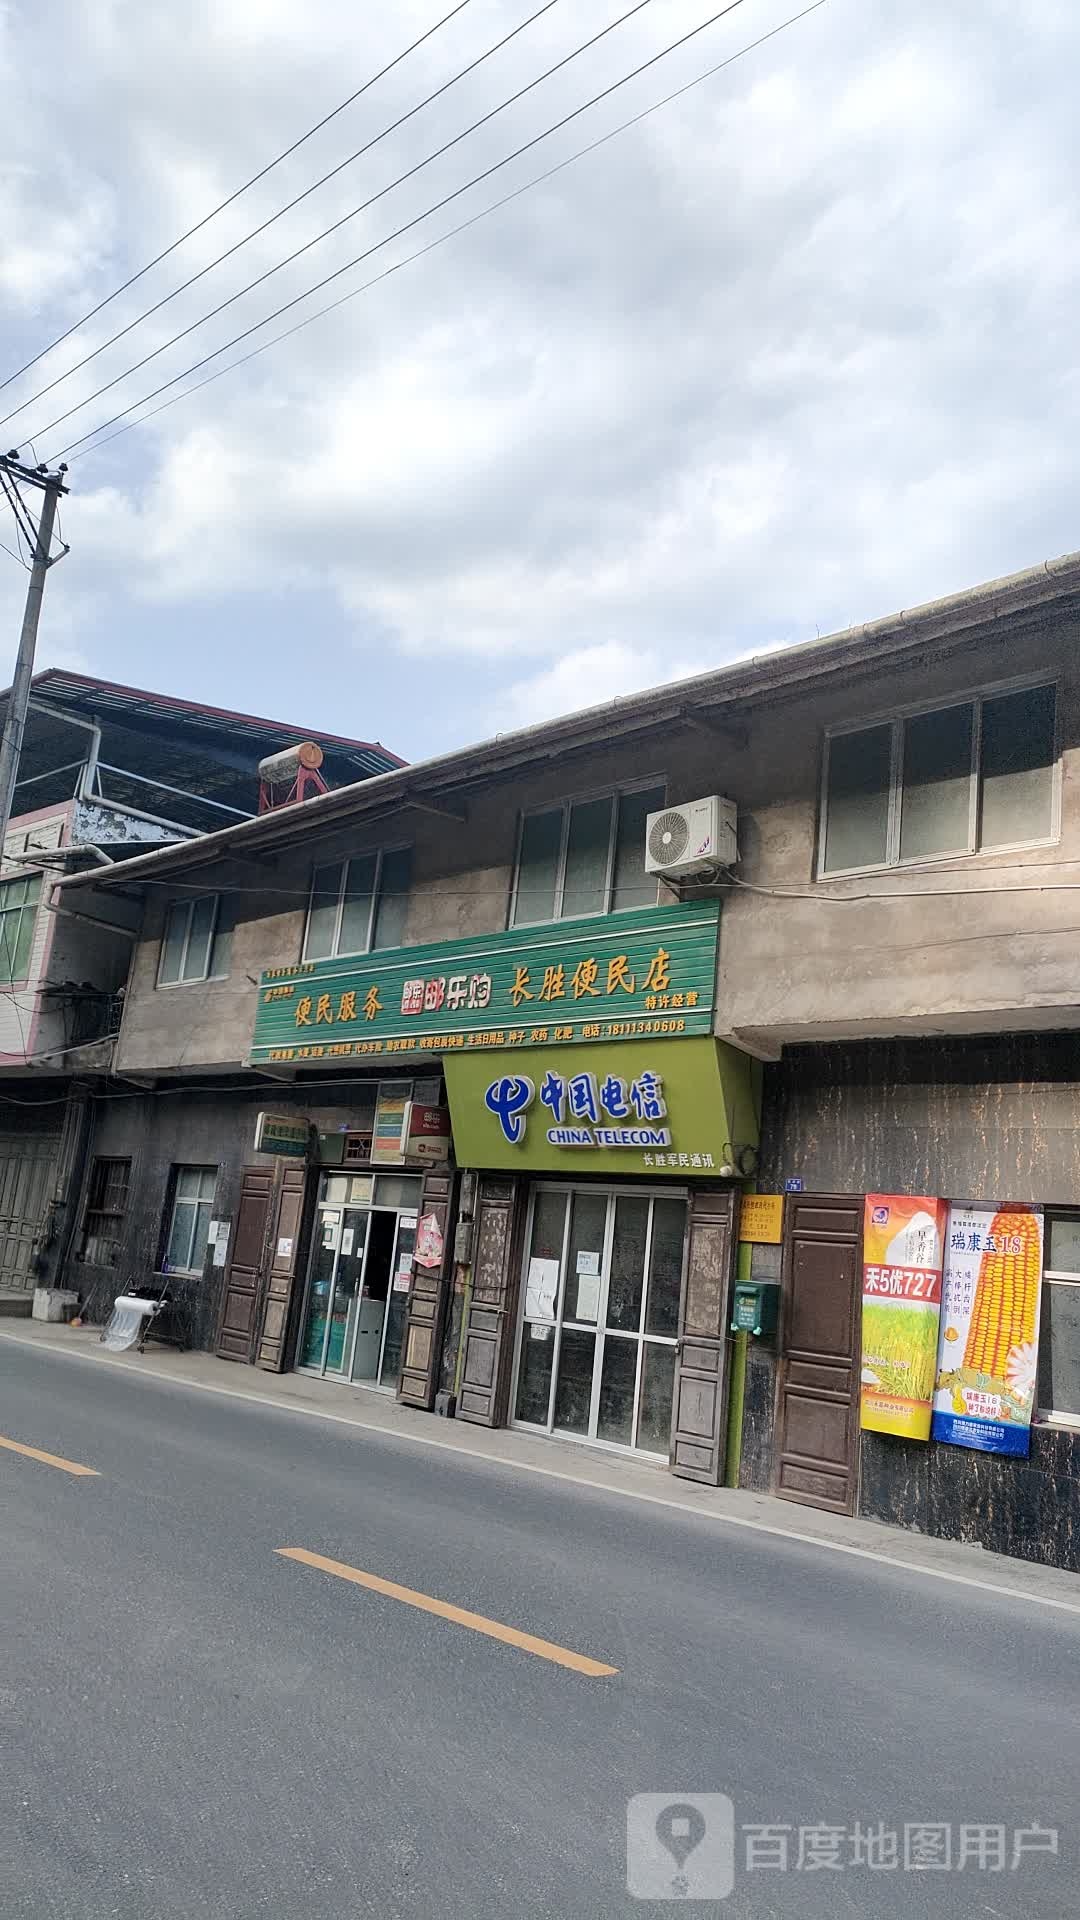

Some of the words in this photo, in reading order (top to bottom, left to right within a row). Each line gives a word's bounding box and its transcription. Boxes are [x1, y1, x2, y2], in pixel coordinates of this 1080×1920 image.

[509, 948, 671, 1007] 长胜便民店
[424, 973, 491, 1011] 邮乐购
[645, 991, 698, 1010] 特许经营
[294, 986, 383, 1027] 便民服务
[467, 1031, 504, 1046] 生活日用品
[508, 1031, 525, 1043] 种子
[530, 1027, 548, 1041] 农药
[553, 1026, 574, 1040] 化肥
[540, 1070, 665, 1124] 中国电信
[547, 1128, 592, 1145] CHINA
[595, 1129, 667, 1146] TELECOM
[642, 1152, 715, 1168] 长胜军民通讯
[950, 1231, 1021, 1254] 瑞康玉18
